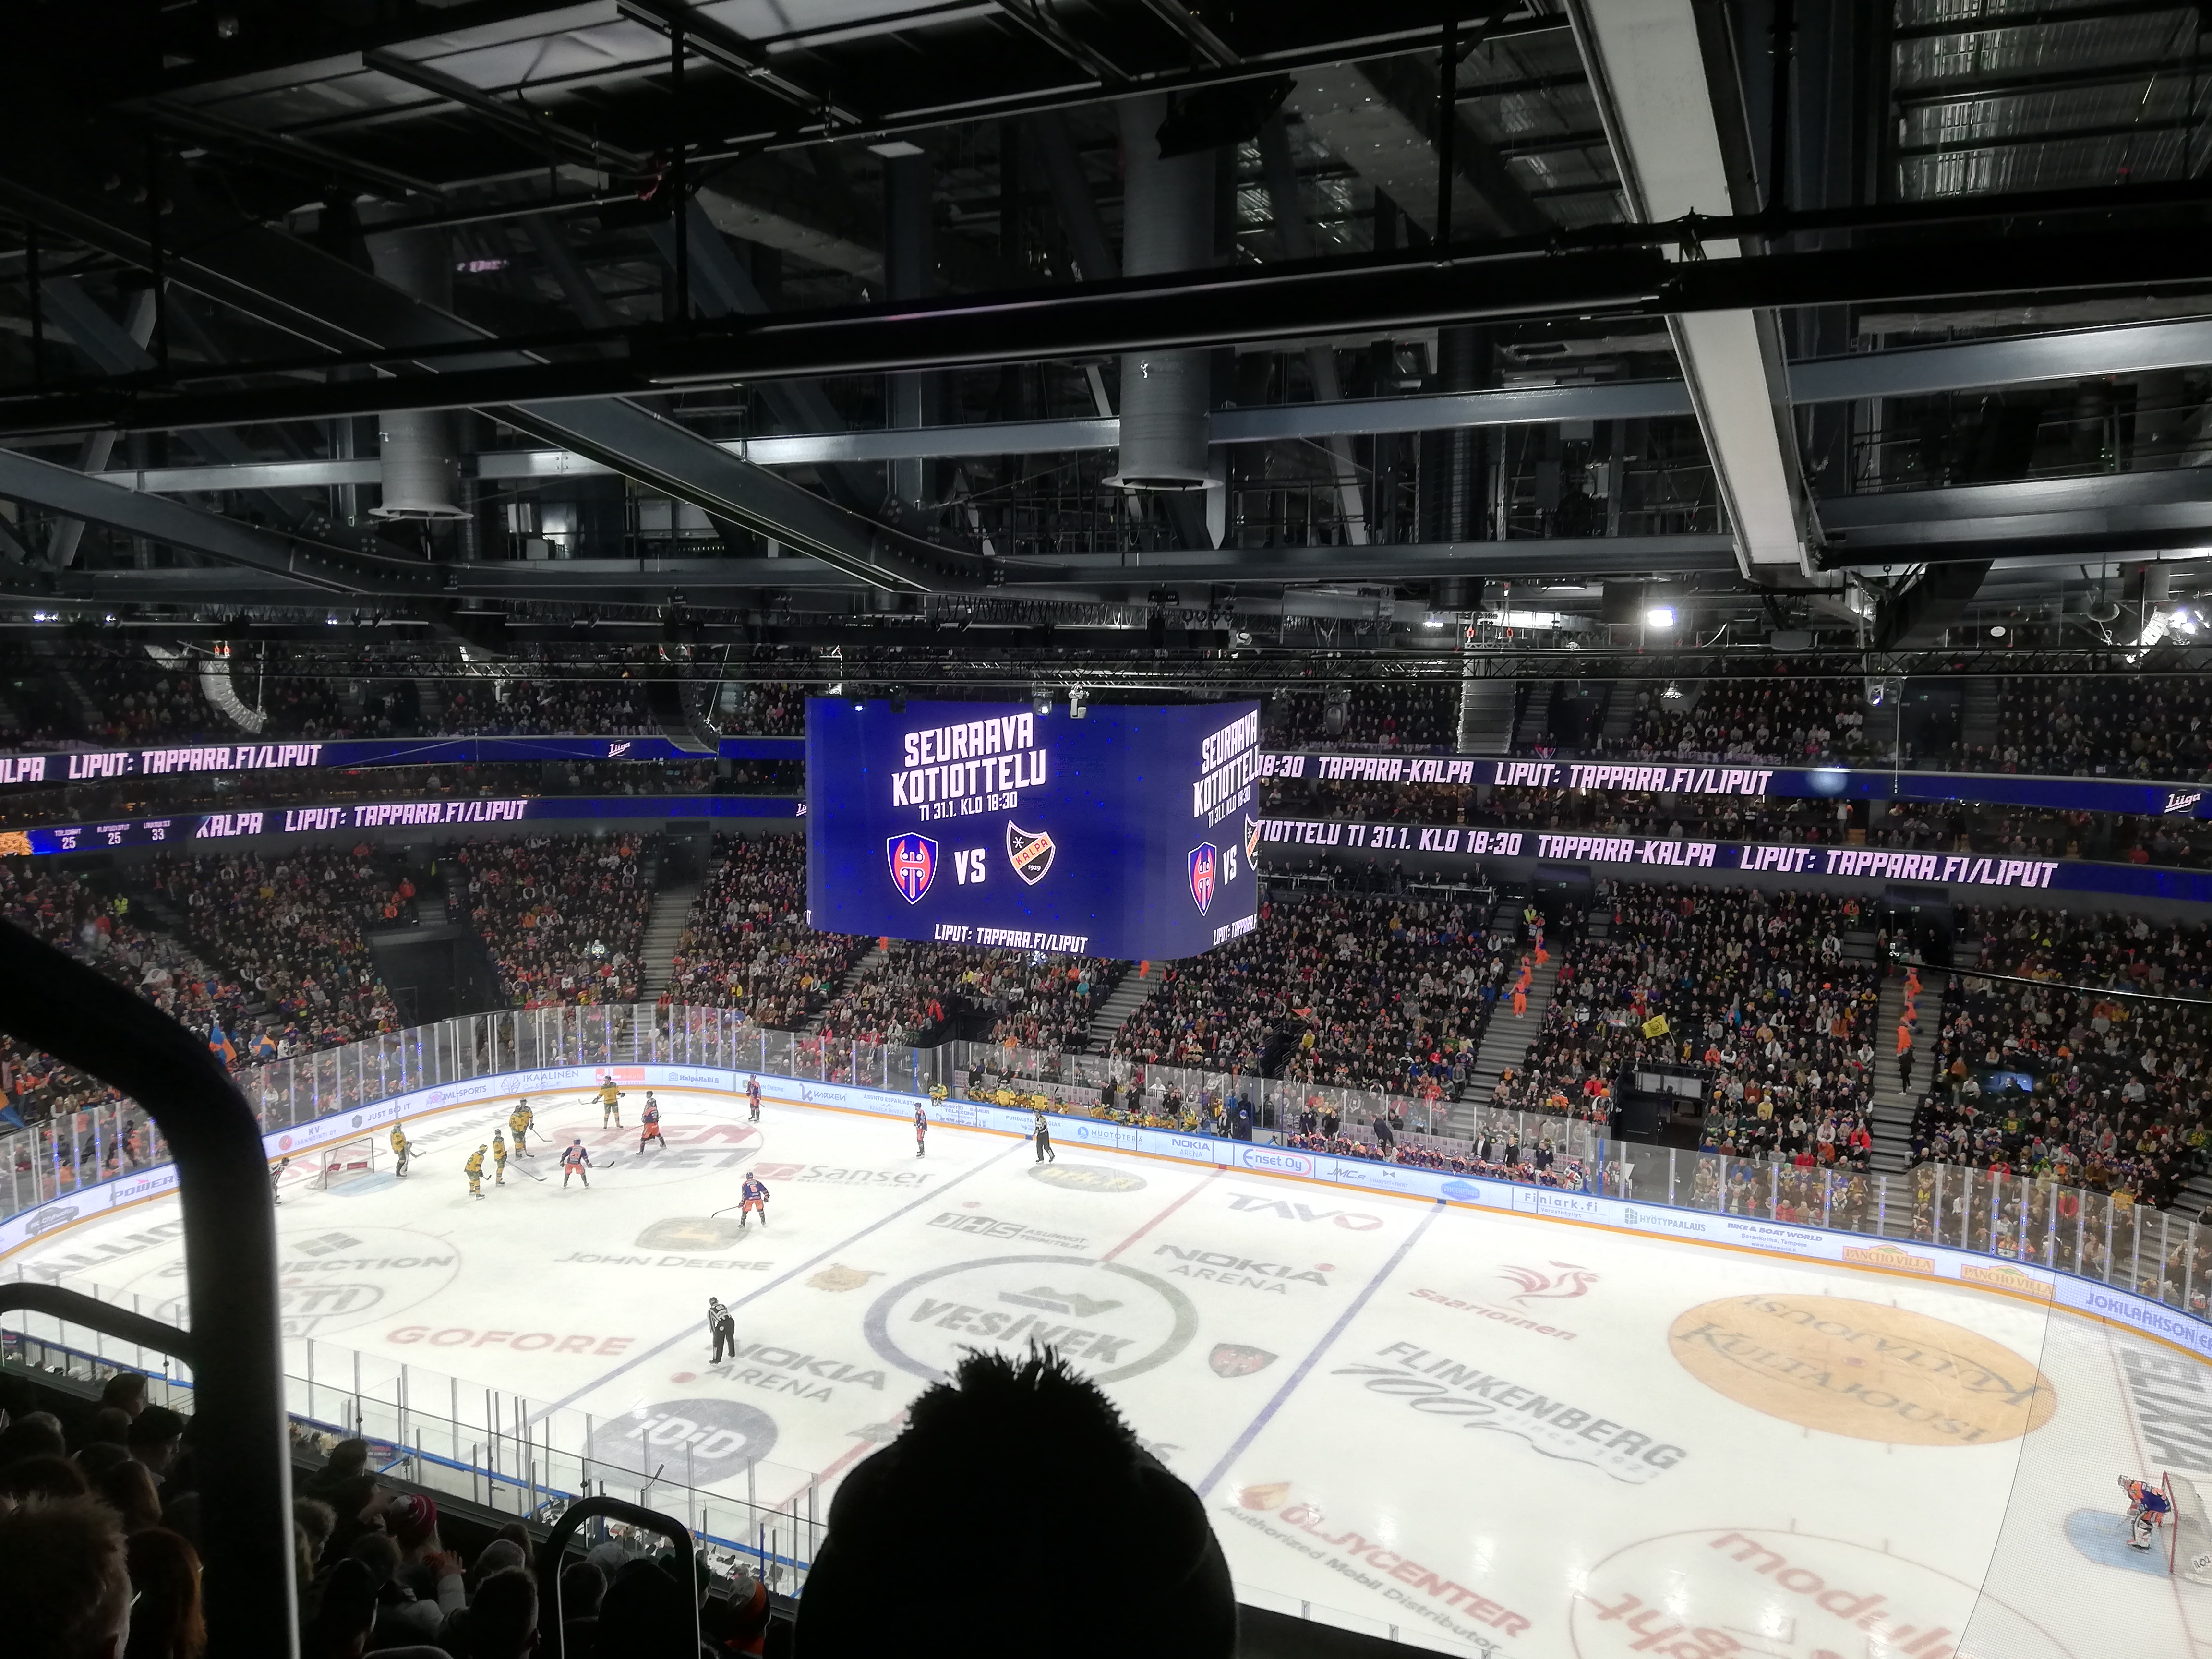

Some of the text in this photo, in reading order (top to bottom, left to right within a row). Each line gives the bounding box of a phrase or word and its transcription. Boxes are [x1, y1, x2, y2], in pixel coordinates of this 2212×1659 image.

[904, 712, 1034, 768] SEURAAVA
[1201, 709, 1258, 775] SEURAAVA
[69, 754, 134, 779] LIPUT:
[141, 744, 322, 774] TAPPARA.FI/LIPUT
[891, 749, 1046, 807] KOTIOTTELU
[1318, 756, 1474, 784] TAPPARA-KALPA
[1494, 762, 1563, 787] LIPUT:
[1569, 764, 1773, 796] TAPPARA.FI/LIPUT
[285, 807, 347, 832] LIPUT:
[354, 799, 528, 827] TAPPARA.FI/LIPUT
[919, 790, 1018, 821] TI 31.1. KLO 18:30
[62, 837, 76, 849] 25
[108, 832, 121, 845] 25
[152, 828, 164, 841] 33
[1014, 835, 1050, 867] KALPA
[1347, 824, 1367, 847] TI
[1370, 826, 1411, 850] 31.1.
[1419, 828, 1460, 852] KLO
[1467, 831, 1523, 856] 18:30
[1537, 835, 1717, 868] TAPPARA-KALPA
[1740, 845, 1817, 873] LIPUT:
[1826, 848, 2060, 889] TAPPARA.FI/LIPUT
[954, 848, 986, 885] VS
[1027, 864, 1042, 873] 1929
[1223, 844, 1237, 885] VS
[934, 923, 1089, 954] LIPUT: TAPPARA.FI/LIPUT
[523, 1070, 579, 1082] IKAALINEN
[679, 1075, 719, 1084] HalpaHalli.fi
[442, 1085, 487, 1101] JML-SPORTS
[864, 1094, 884, 1102] ASUNTO
[368, 1109, 386, 1121] JUST
[1006, 1115, 1033, 1123] PUHDASTA
[1091, 1130, 1143, 1142] MUOTOTERÄ
[1172, 1138, 1210, 1151] NOKIA
[1179, 1149, 1203, 1158] ARENA
[803, 1165, 936, 1185] Sanser
[1285, 1157, 1302, 1172] Oy
[1524, 1192, 1599, 1213] Finlark.fi
[1541, 1207, 1582, 1219] Varastohyllyt
[1640, 1213, 1706, 1232] HYÖTYPAALAUS
[1727, 1223, 1748, 1231] BIKE
[1758, 1227, 1785, 1236] BOAT
[1787, 1231, 1823, 1242] WORLD
[1026, 1229, 1088, 1244] ASUNNOT
[1780, 1238, 1807, 1248] Tampere
[553, 1251, 775, 1272] JOHN DEERE
[1153, 1244, 1329, 1286] NOKIA
[1845, 1248, 1932, 1270] PANCHO VILLA
[1168, 1264, 1287, 1295] ARENA
[1962, 1266, 2053, 1295] PANCHO VILLA
[1408, 1288, 1578, 1342] Saarioinen
[386, 1325, 635, 1357] GOFORE
[704, 1361, 835, 1403] ARENA
[1375, 1340, 1688, 1471] FLINKENBERG
[1221, 1506, 1503, 1652] Authorized Mobil Distributor
